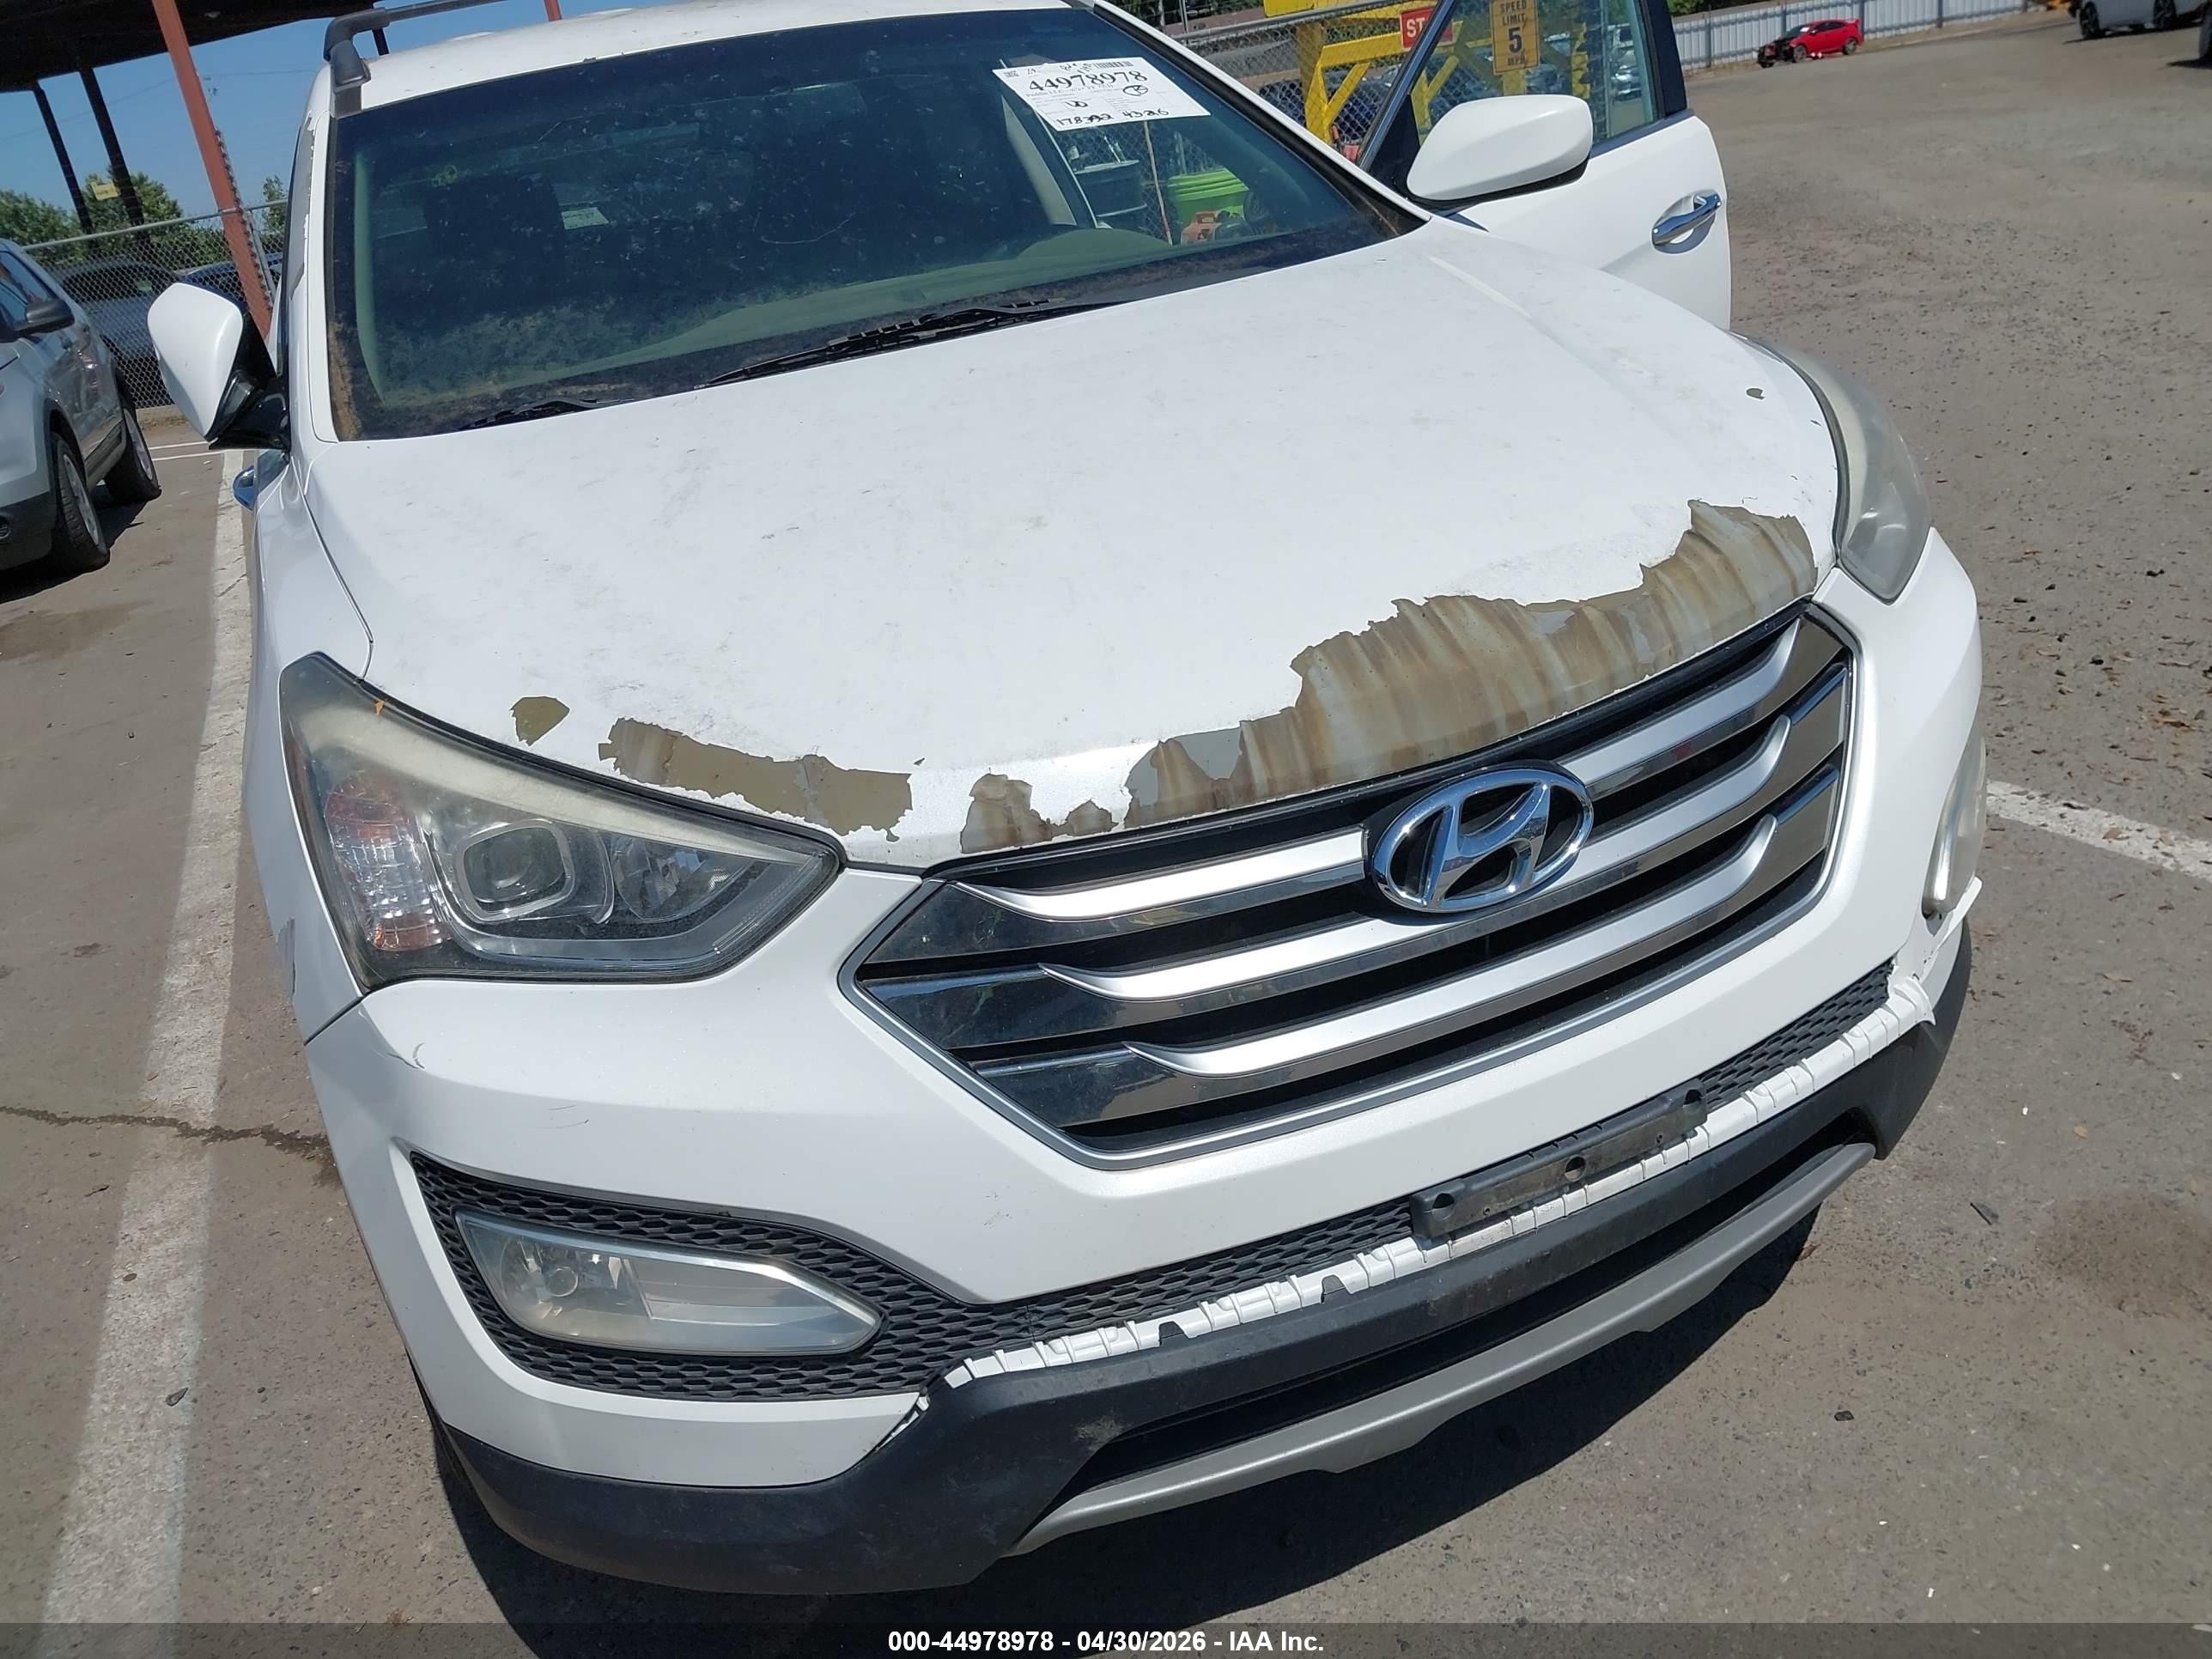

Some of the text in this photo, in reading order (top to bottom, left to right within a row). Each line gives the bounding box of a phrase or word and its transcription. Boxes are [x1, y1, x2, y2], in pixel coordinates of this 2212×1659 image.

[1500, 0, 1527, 13] SPEED
[1407, 18, 1425, 38] ST
[1502, 13, 1526, 26] LIMIT
[1508, 27, 1522, 53] 5
[1029, 70, 1148, 91] 44978978
